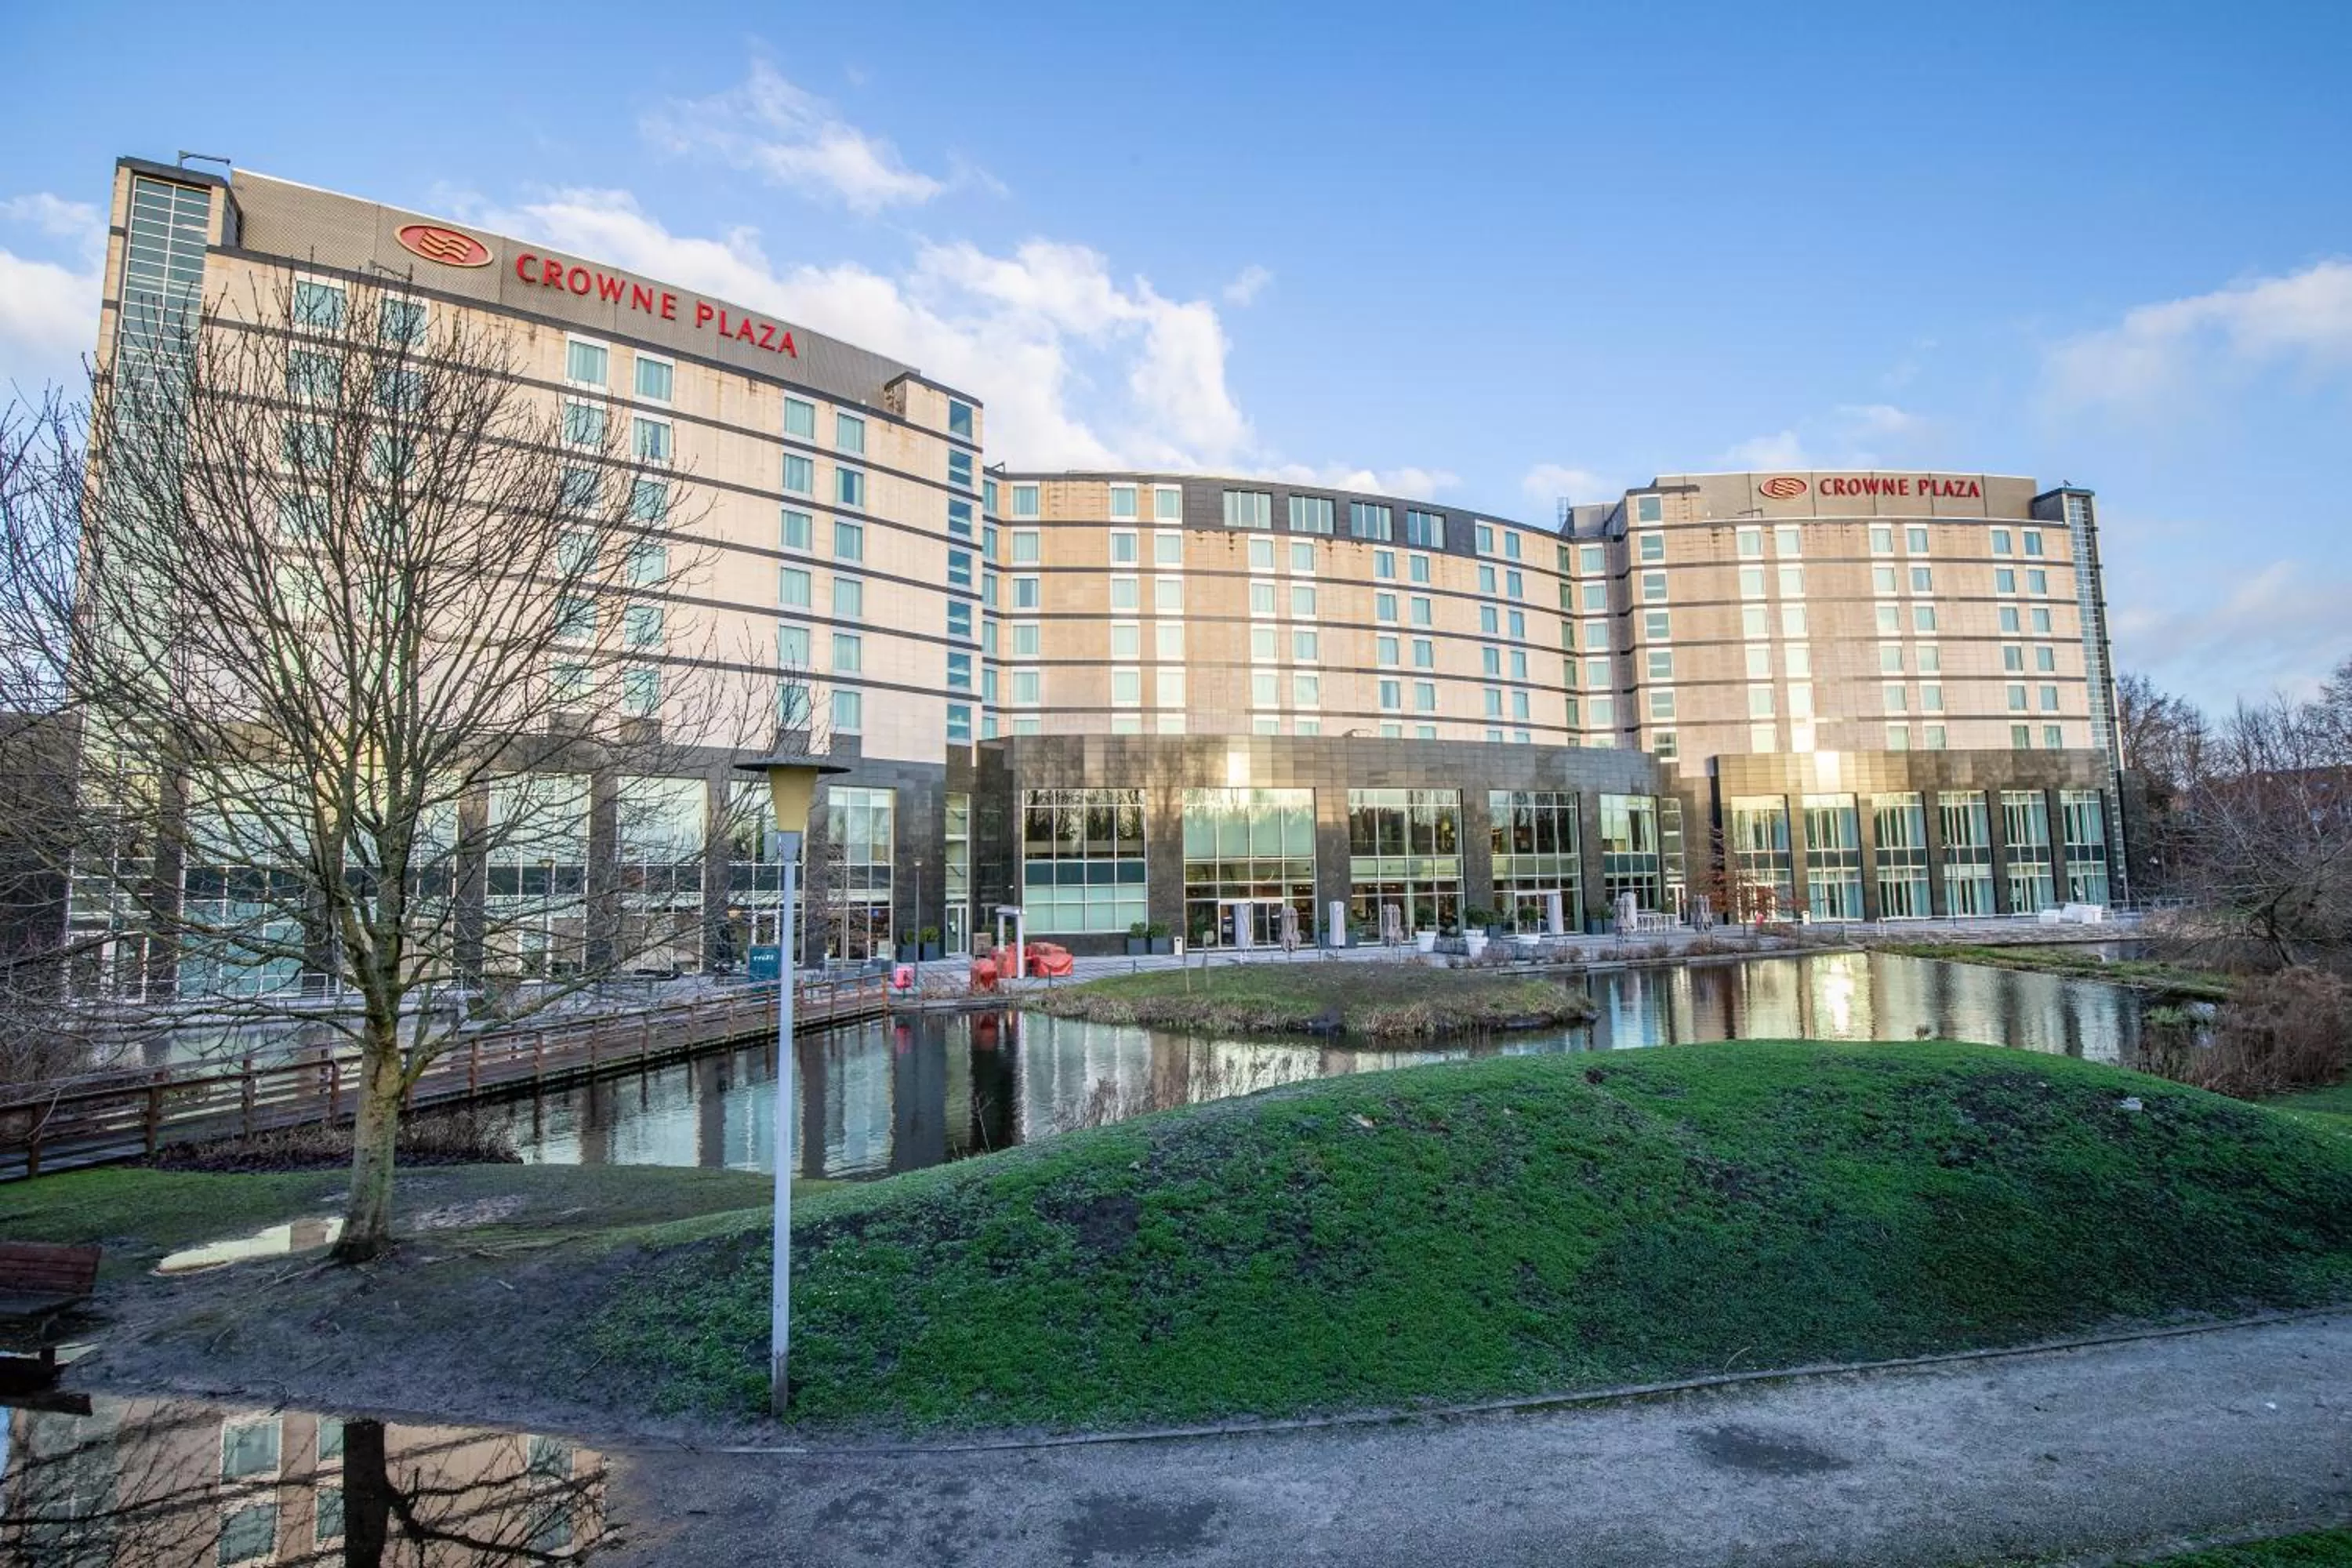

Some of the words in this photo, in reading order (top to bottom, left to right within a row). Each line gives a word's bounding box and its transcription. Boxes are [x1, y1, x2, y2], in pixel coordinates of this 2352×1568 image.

[515, 252, 677, 321] CROWNE
[695, 299, 798, 359] PLAZA
[1820, 477, 1909, 496] CROWNE
[1918, 478, 1980, 497] PLAZA
